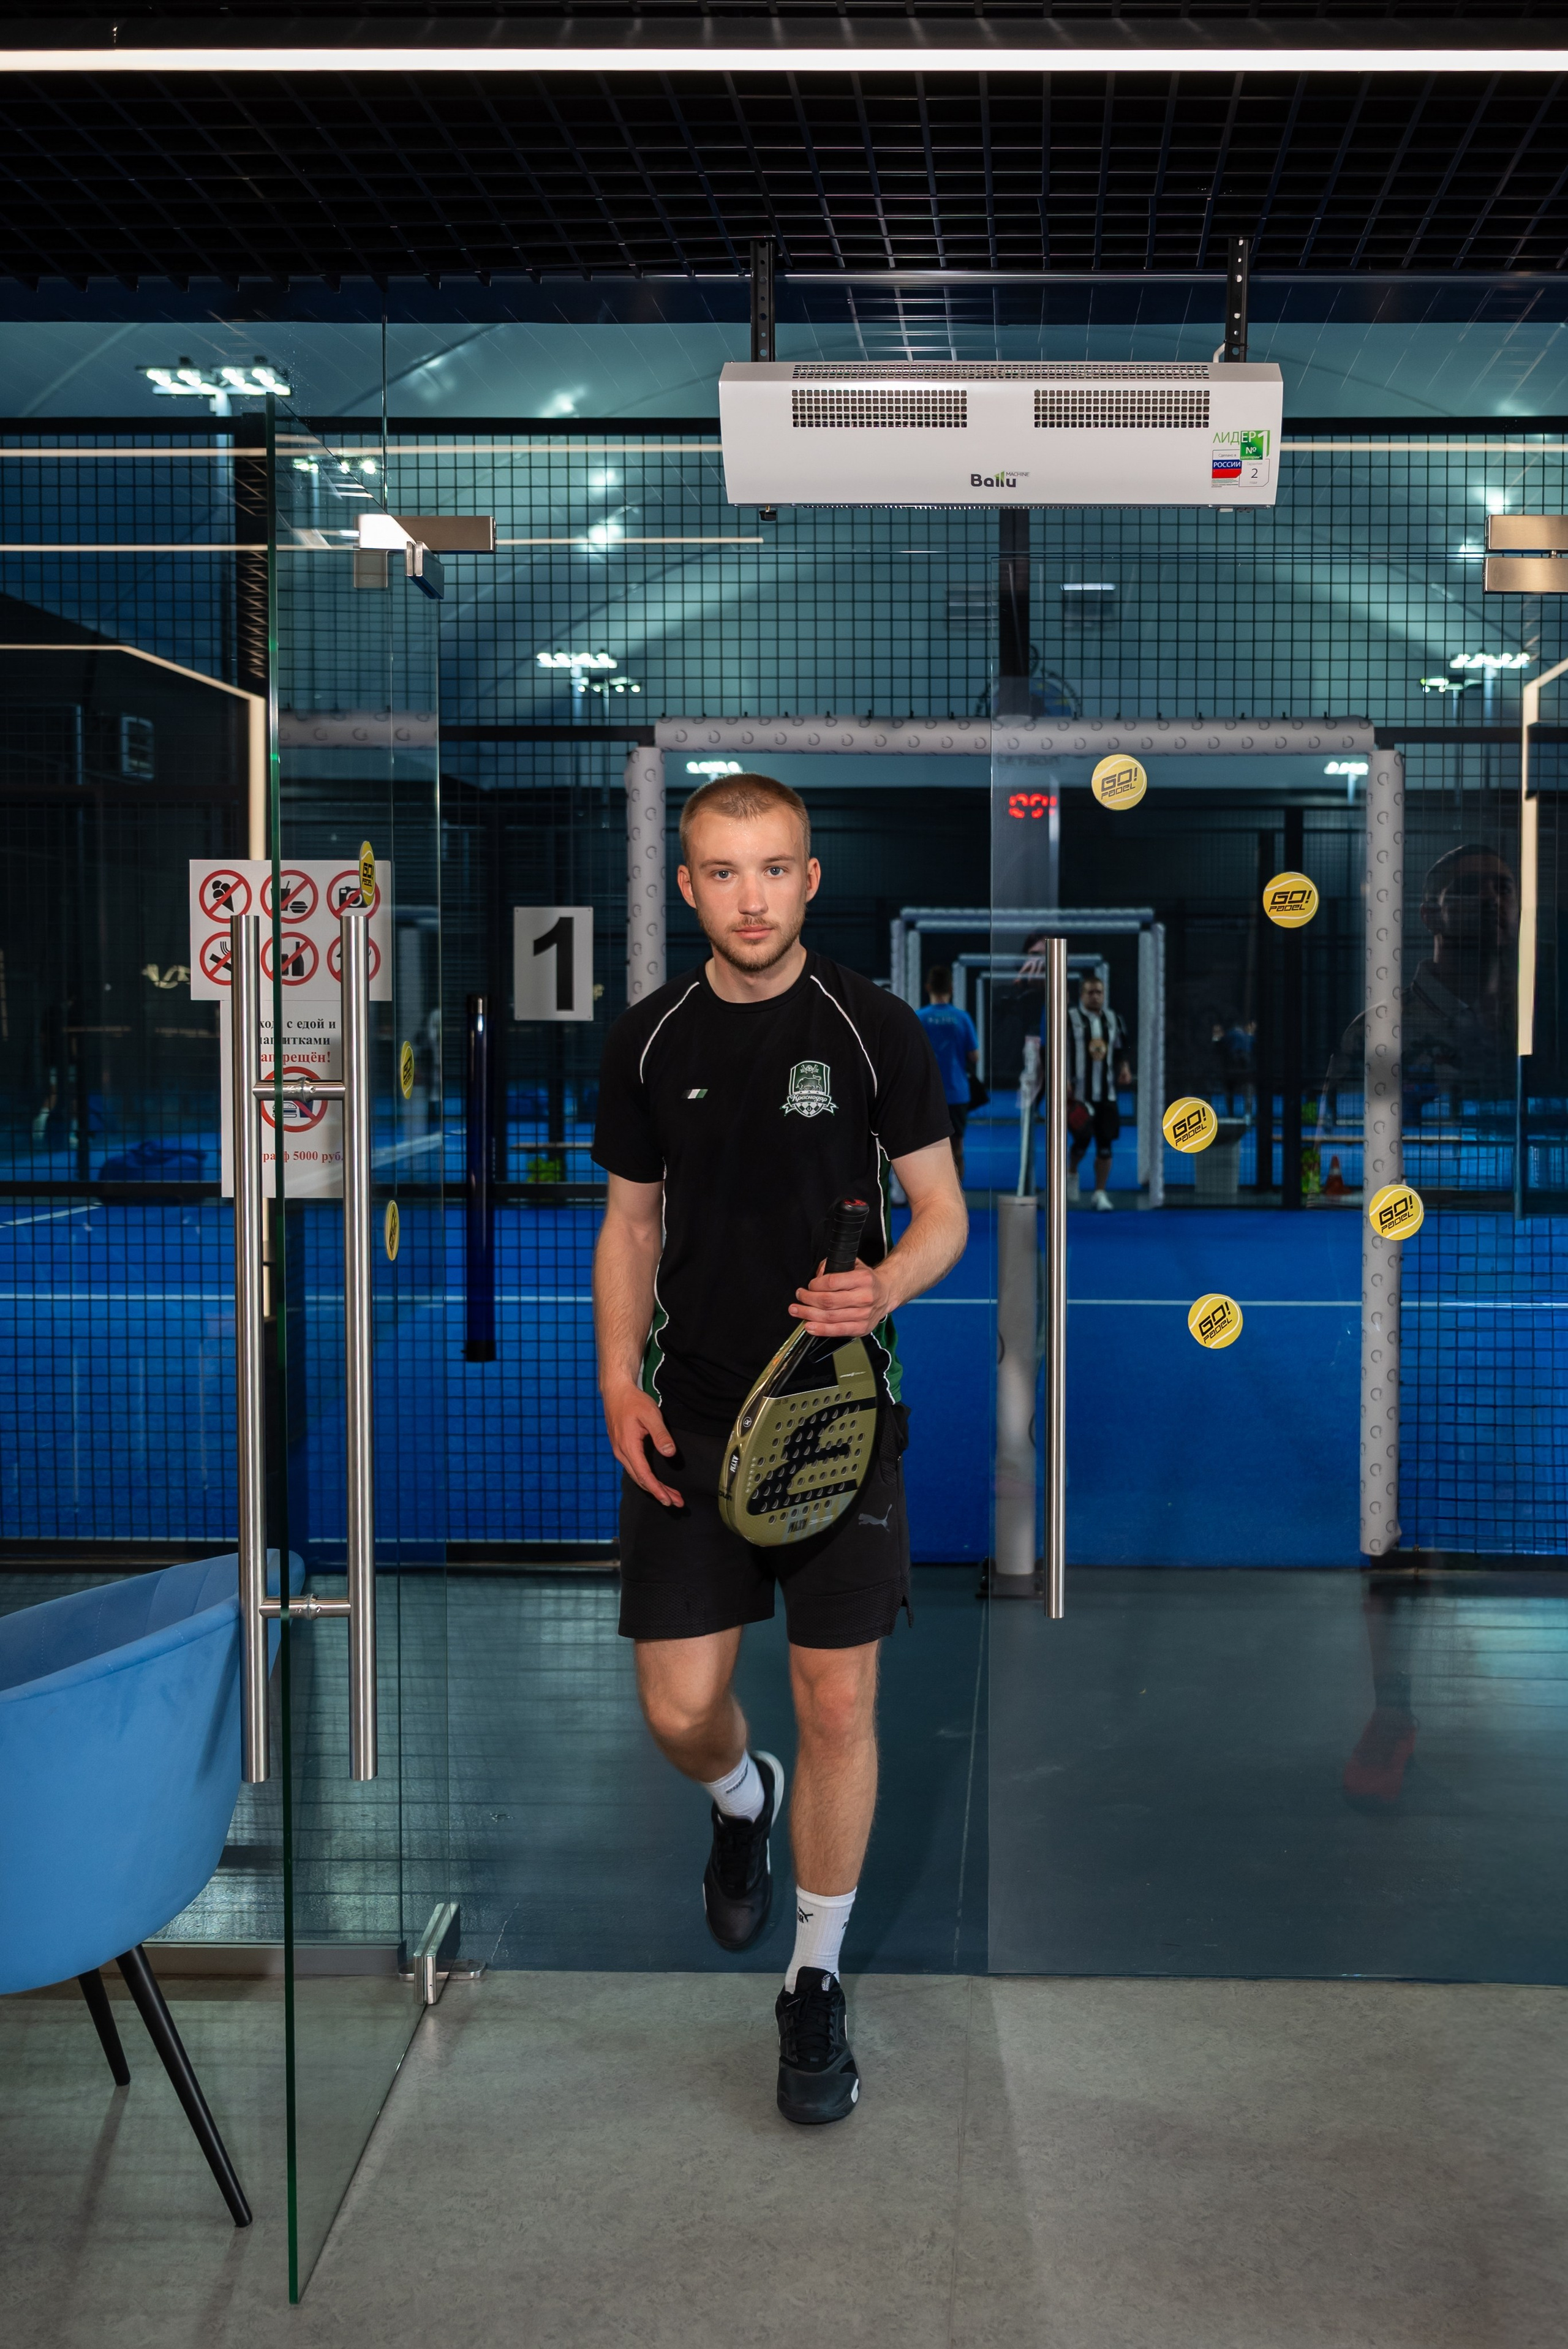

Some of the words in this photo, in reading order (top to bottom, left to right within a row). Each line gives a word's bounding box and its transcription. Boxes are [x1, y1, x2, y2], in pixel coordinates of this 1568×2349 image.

[1213, 431, 1256, 445] ЛИДЕР
[971, 471, 1016, 488] Ballu
[1251, 468, 1258, 478] 2
[1101, 767, 1137, 792] GO!
[1270, 890, 1313, 905] GO!
[533, 917, 575, 1011] 1
[297, 1019, 324, 1030] едой
[261, 1052, 331, 1065] апрещён!
[1172, 1107, 1206, 1139] GO!
[293, 1151, 318, 1160] 5000
[322, 1152, 343, 1163] руб.
[1379, 1195, 1413, 1226] GO!
[1199, 1301, 1231, 1337] GO!
